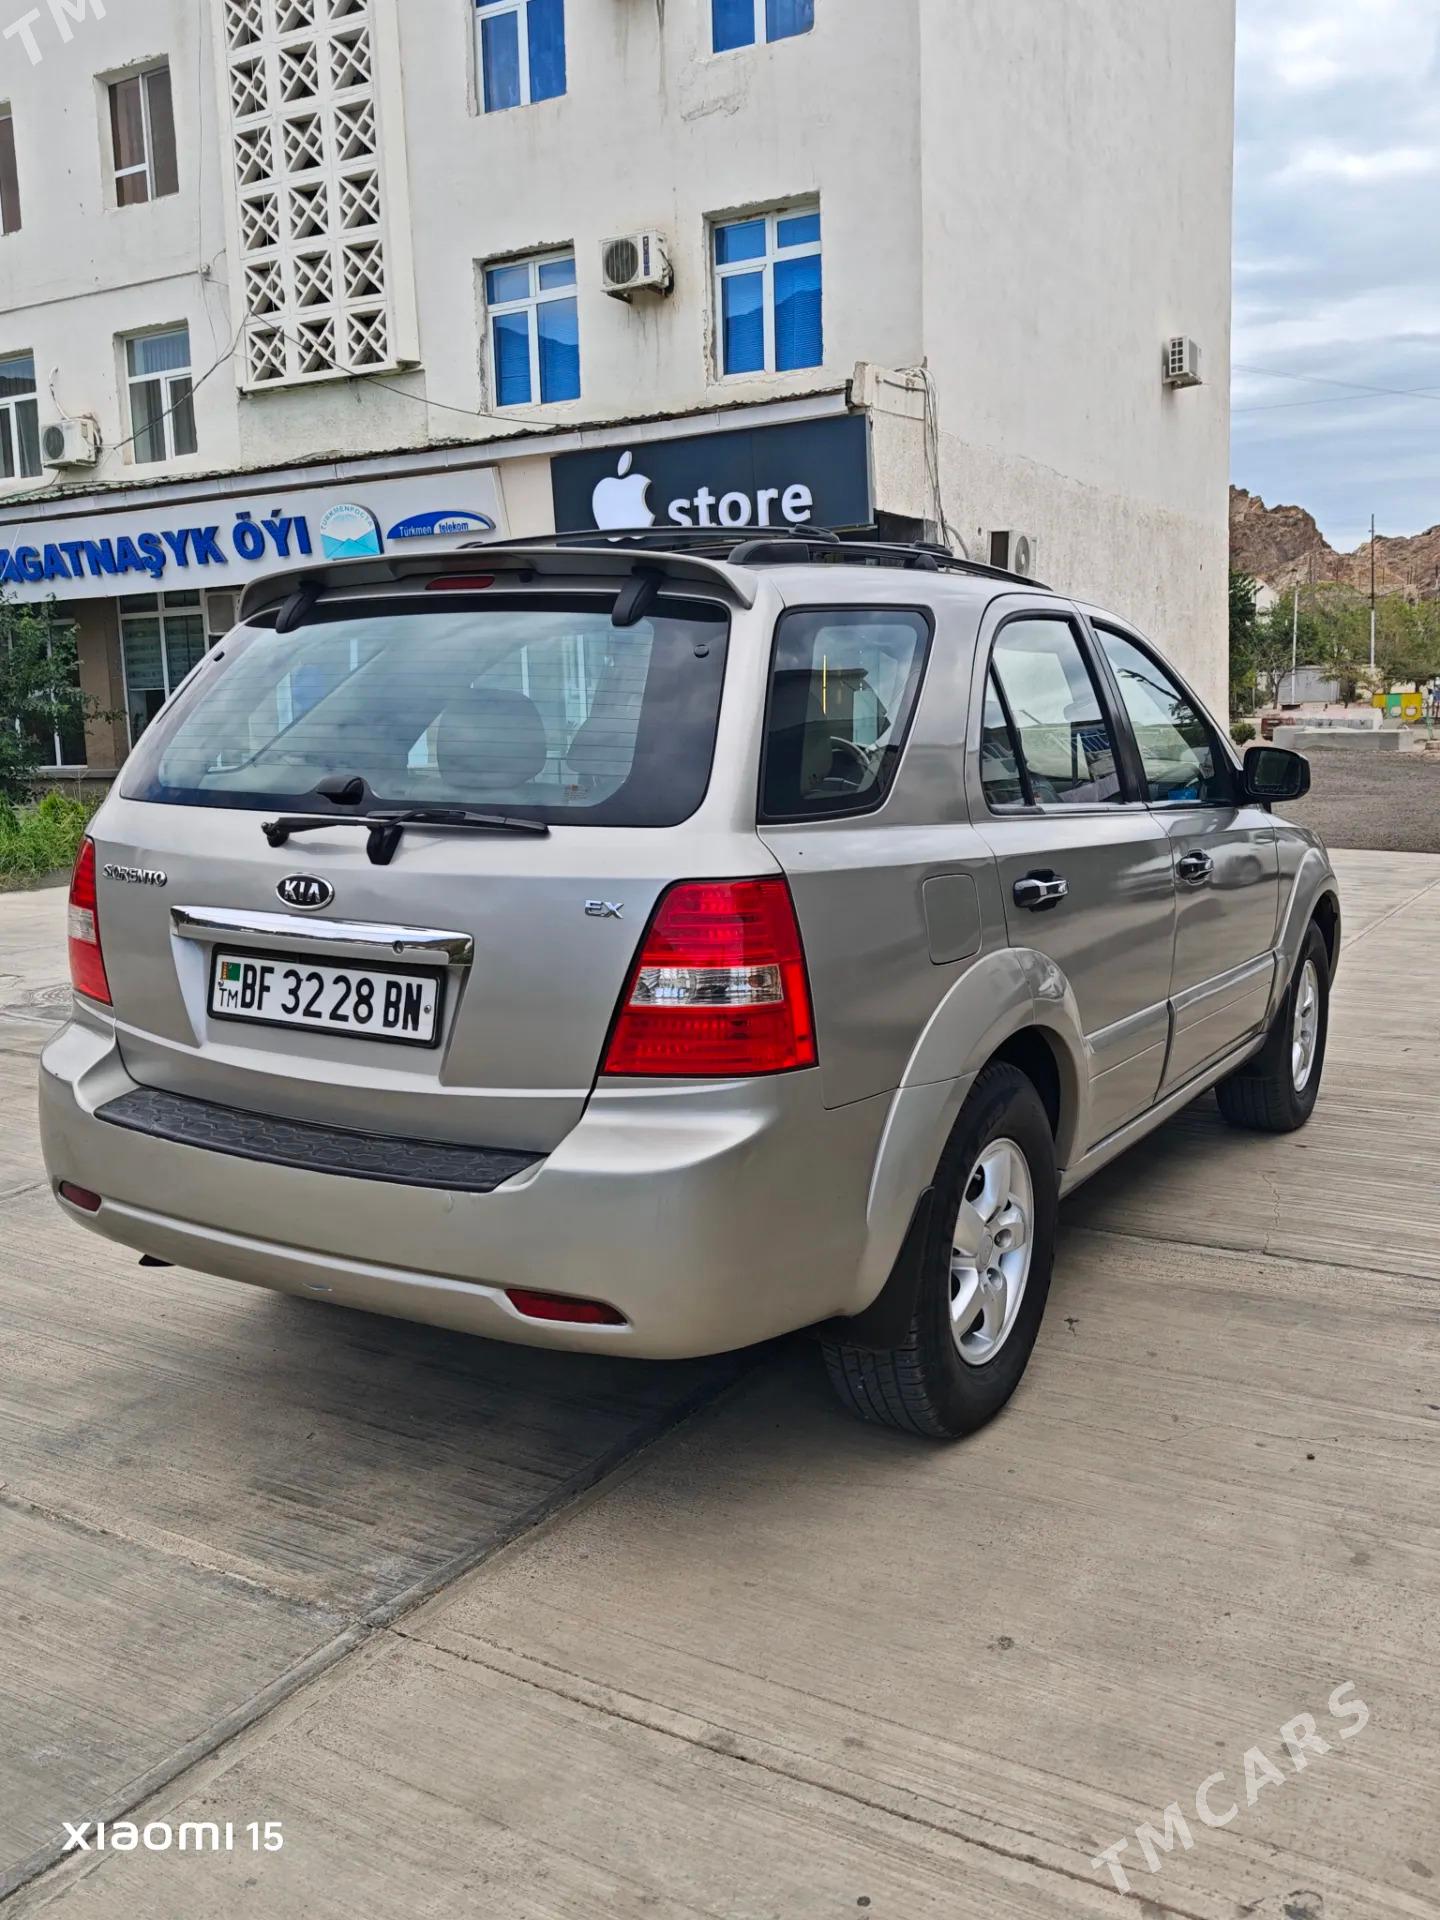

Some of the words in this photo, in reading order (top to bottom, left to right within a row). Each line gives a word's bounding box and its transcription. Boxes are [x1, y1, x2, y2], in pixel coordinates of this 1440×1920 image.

[668, 484, 813, 527] store
[232, 508, 313, 561] ÖÝI
[400, 525, 433, 537] Türkmen
[439, 521, 469, 534] telekom
[102, 863, 168, 887] SORENTO
[284, 880, 320, 903] KIA
[585, 899, 625, 919] EX
[219, 987, 238, 1009] TM
[240, 963, 275, 1010] BF
[281, 968, 375, 1024] 3228
[382, 979, 423, 1032] BN
